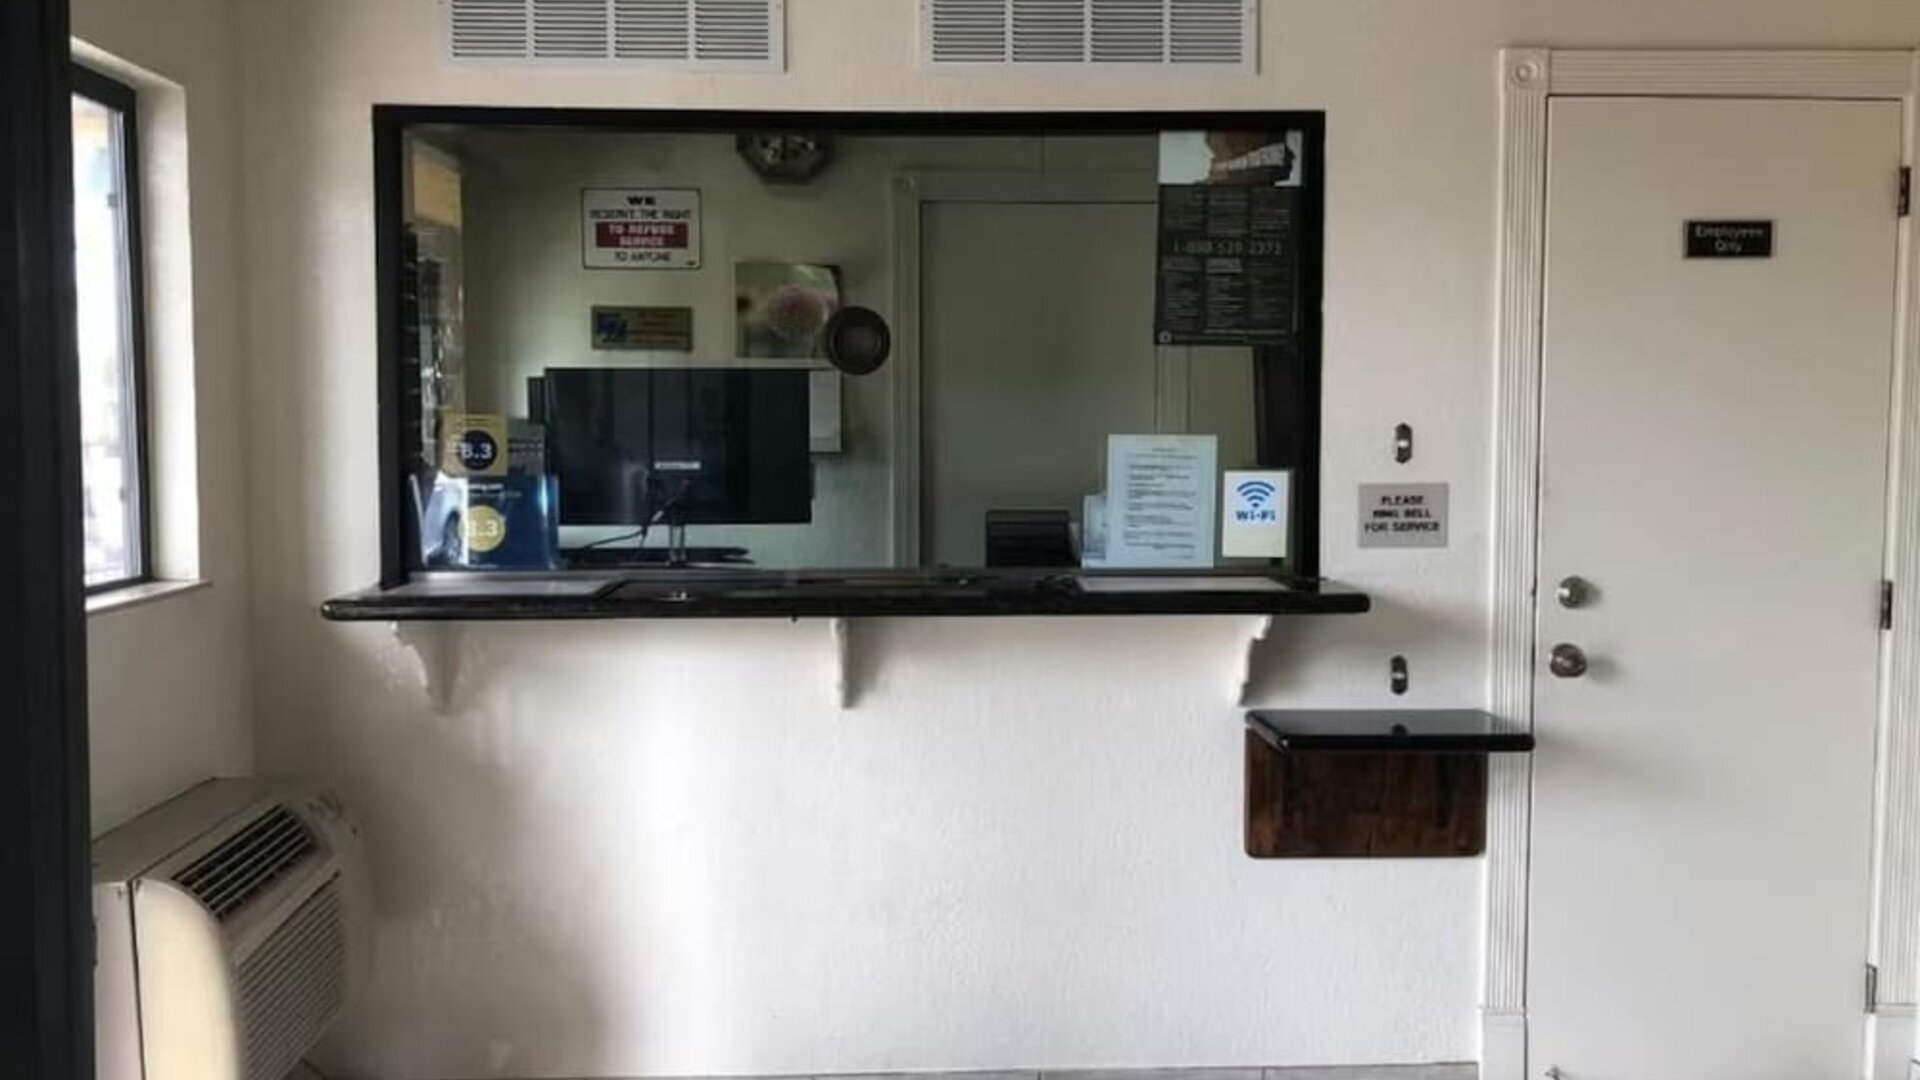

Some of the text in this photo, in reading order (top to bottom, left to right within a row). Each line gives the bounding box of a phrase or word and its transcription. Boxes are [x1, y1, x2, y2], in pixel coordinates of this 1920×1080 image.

[627, 196, 657, 205] WE
[590, 209, 691, 219] RESERVE THE RIGHT
[608, 224, 674, 235] TO REFUSE
[1695, 224, 1764, 238] Employees
[619, 236, 665, 246] SERVICE
[614, 252, 671, 262] TO ANYONE
[1381, 495, 1424, 506] PLEASE
[1235, 510, 1277, 522] Wi-Fi
[1403, 508, 1432, 518] BELL
[1364, 521, 1440, 533] FOR SERVICE
